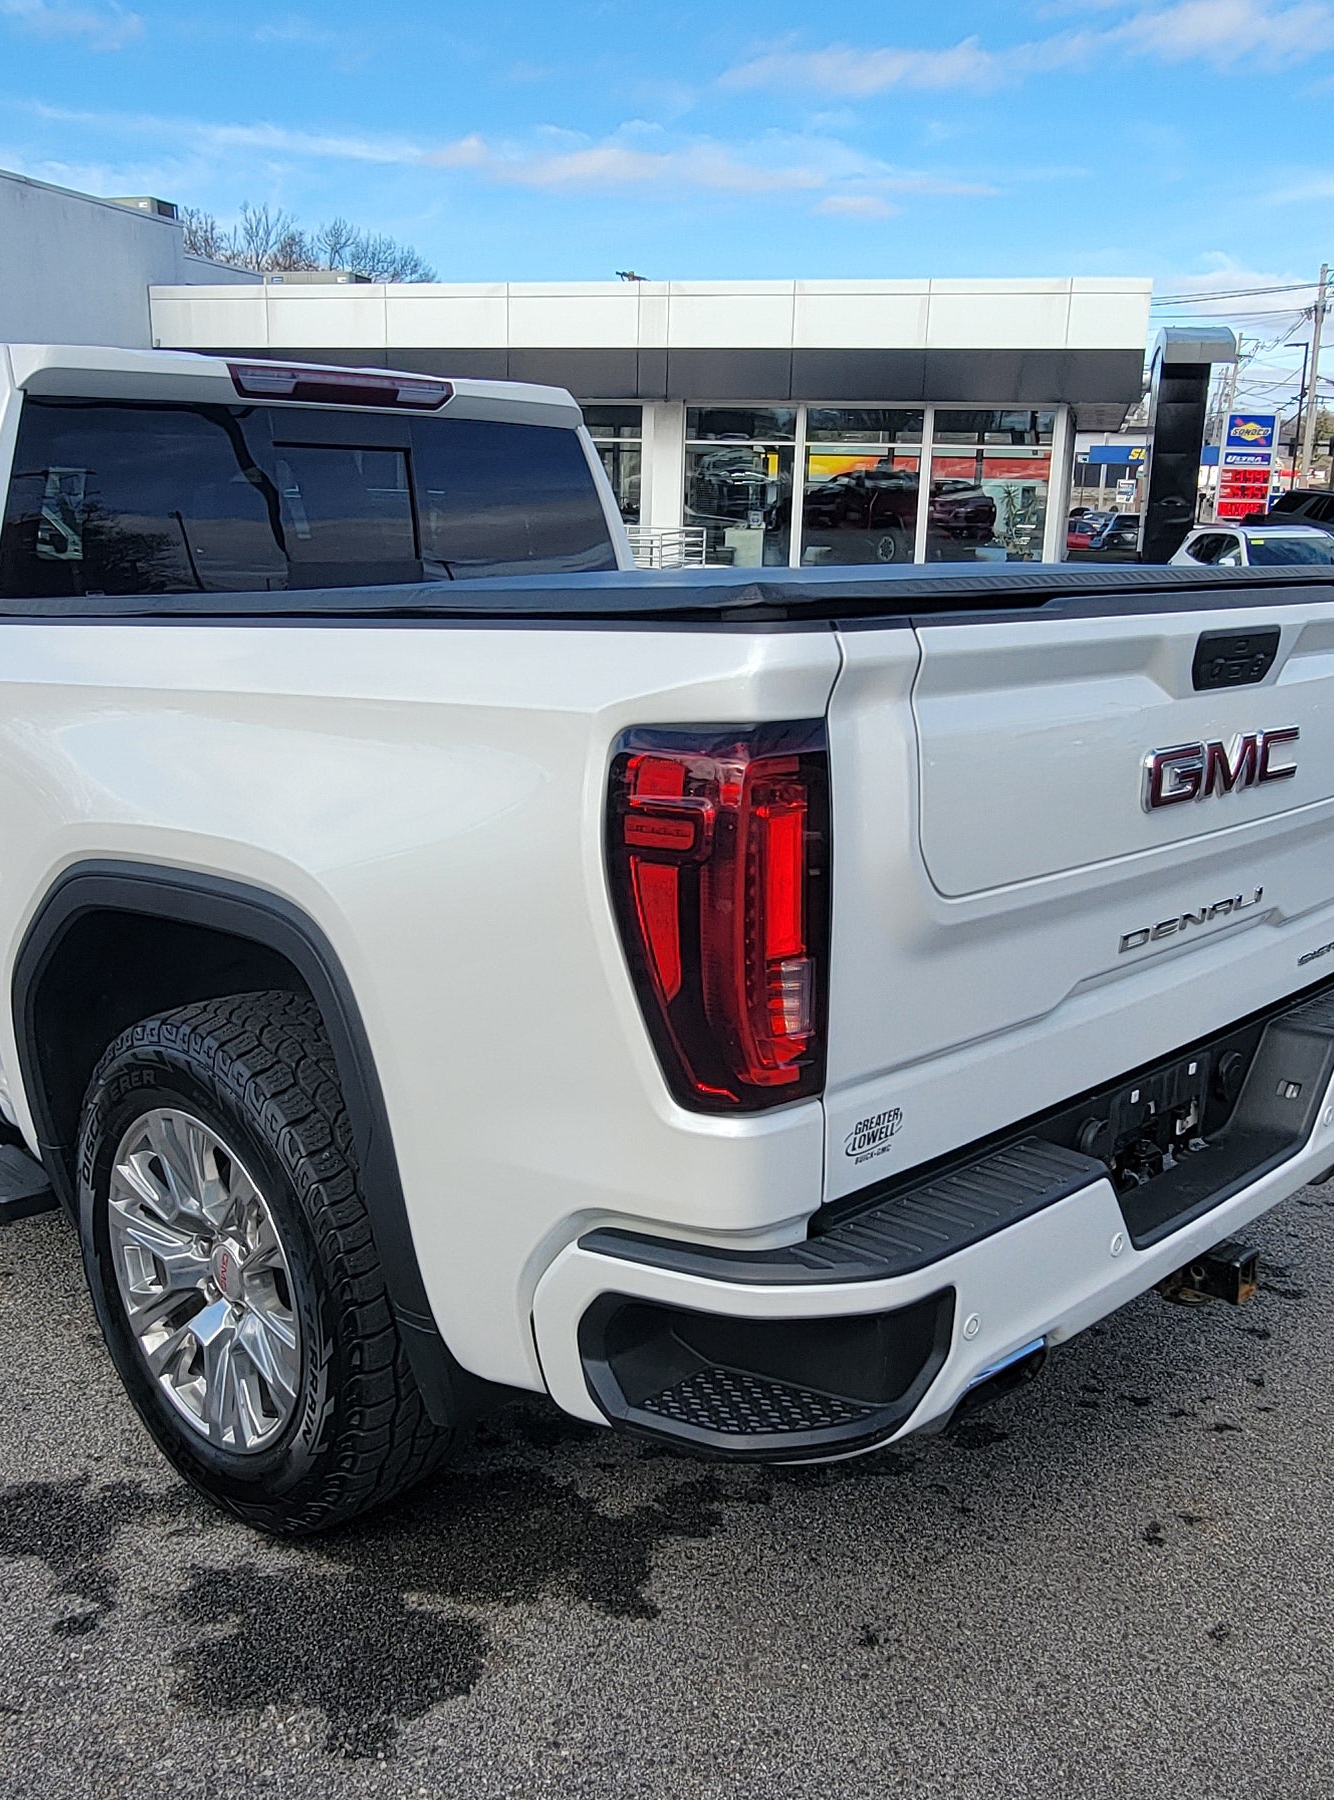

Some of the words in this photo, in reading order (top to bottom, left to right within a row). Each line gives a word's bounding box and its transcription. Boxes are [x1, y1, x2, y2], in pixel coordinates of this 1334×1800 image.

[1141, 725, 1300, 814] GMC
[1119, 885, 1264, 954] DENALI
[851, 1122, 895, 1151] LOWELL
[854, 1107, 900, 1136] GREATER
